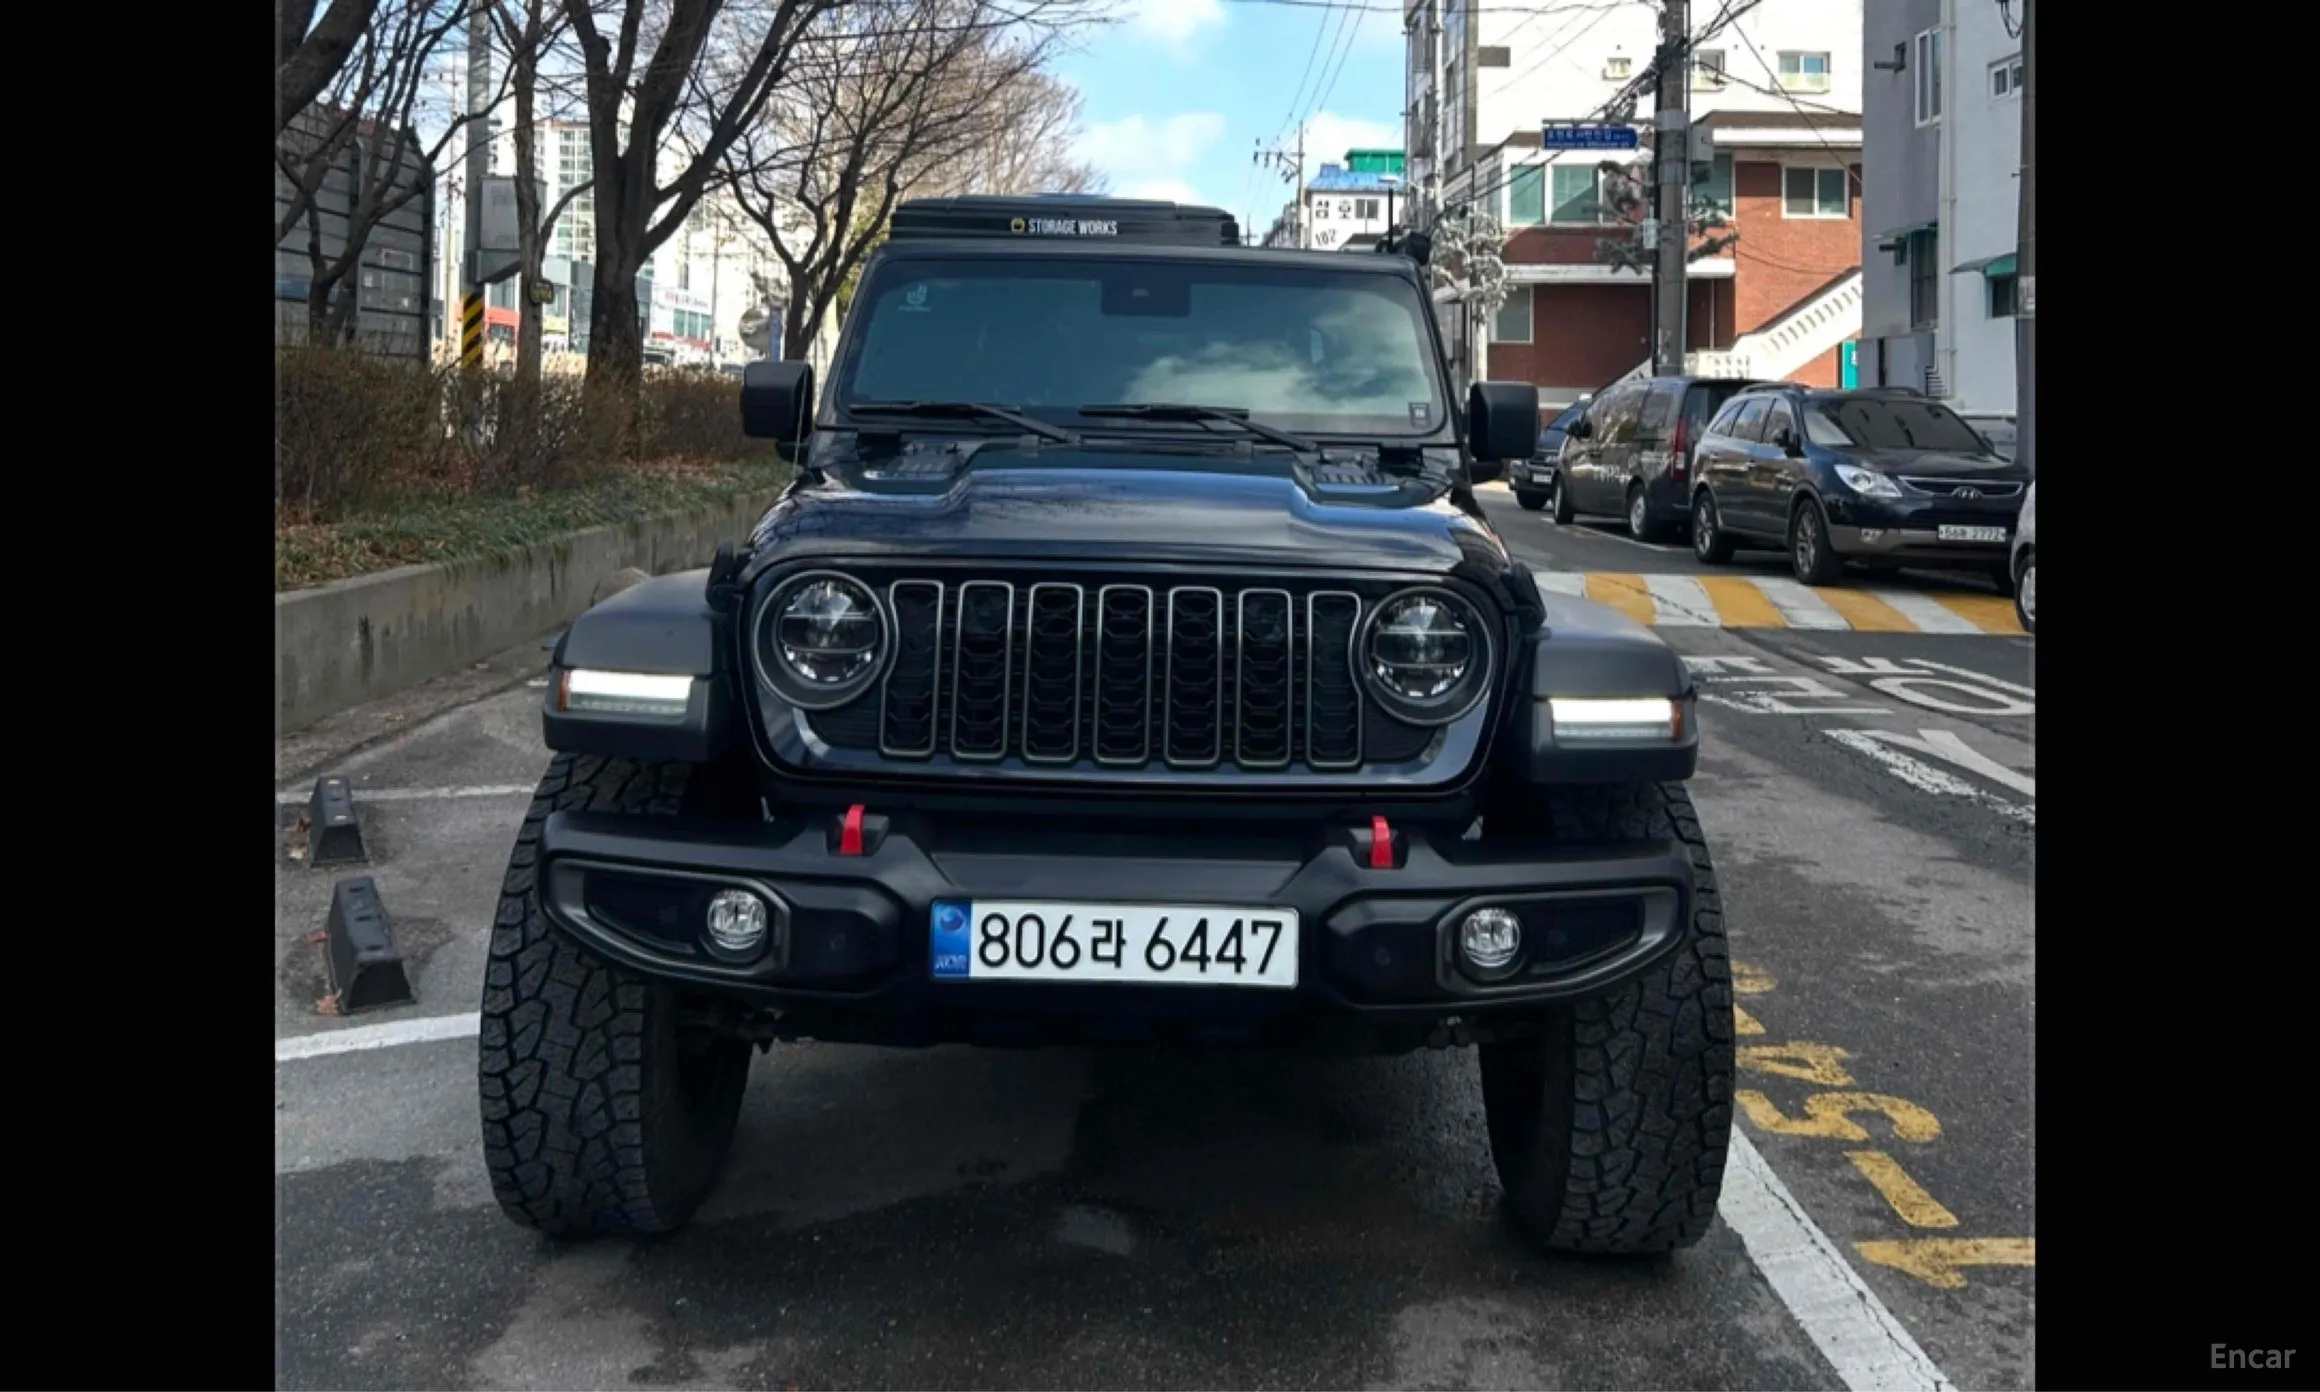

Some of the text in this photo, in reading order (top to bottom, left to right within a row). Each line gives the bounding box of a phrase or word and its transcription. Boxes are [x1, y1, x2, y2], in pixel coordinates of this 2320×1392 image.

[1028, 218, 1117, 236] STORAGE WORKS
[978, 913, 1283, 974] 806라 6447
